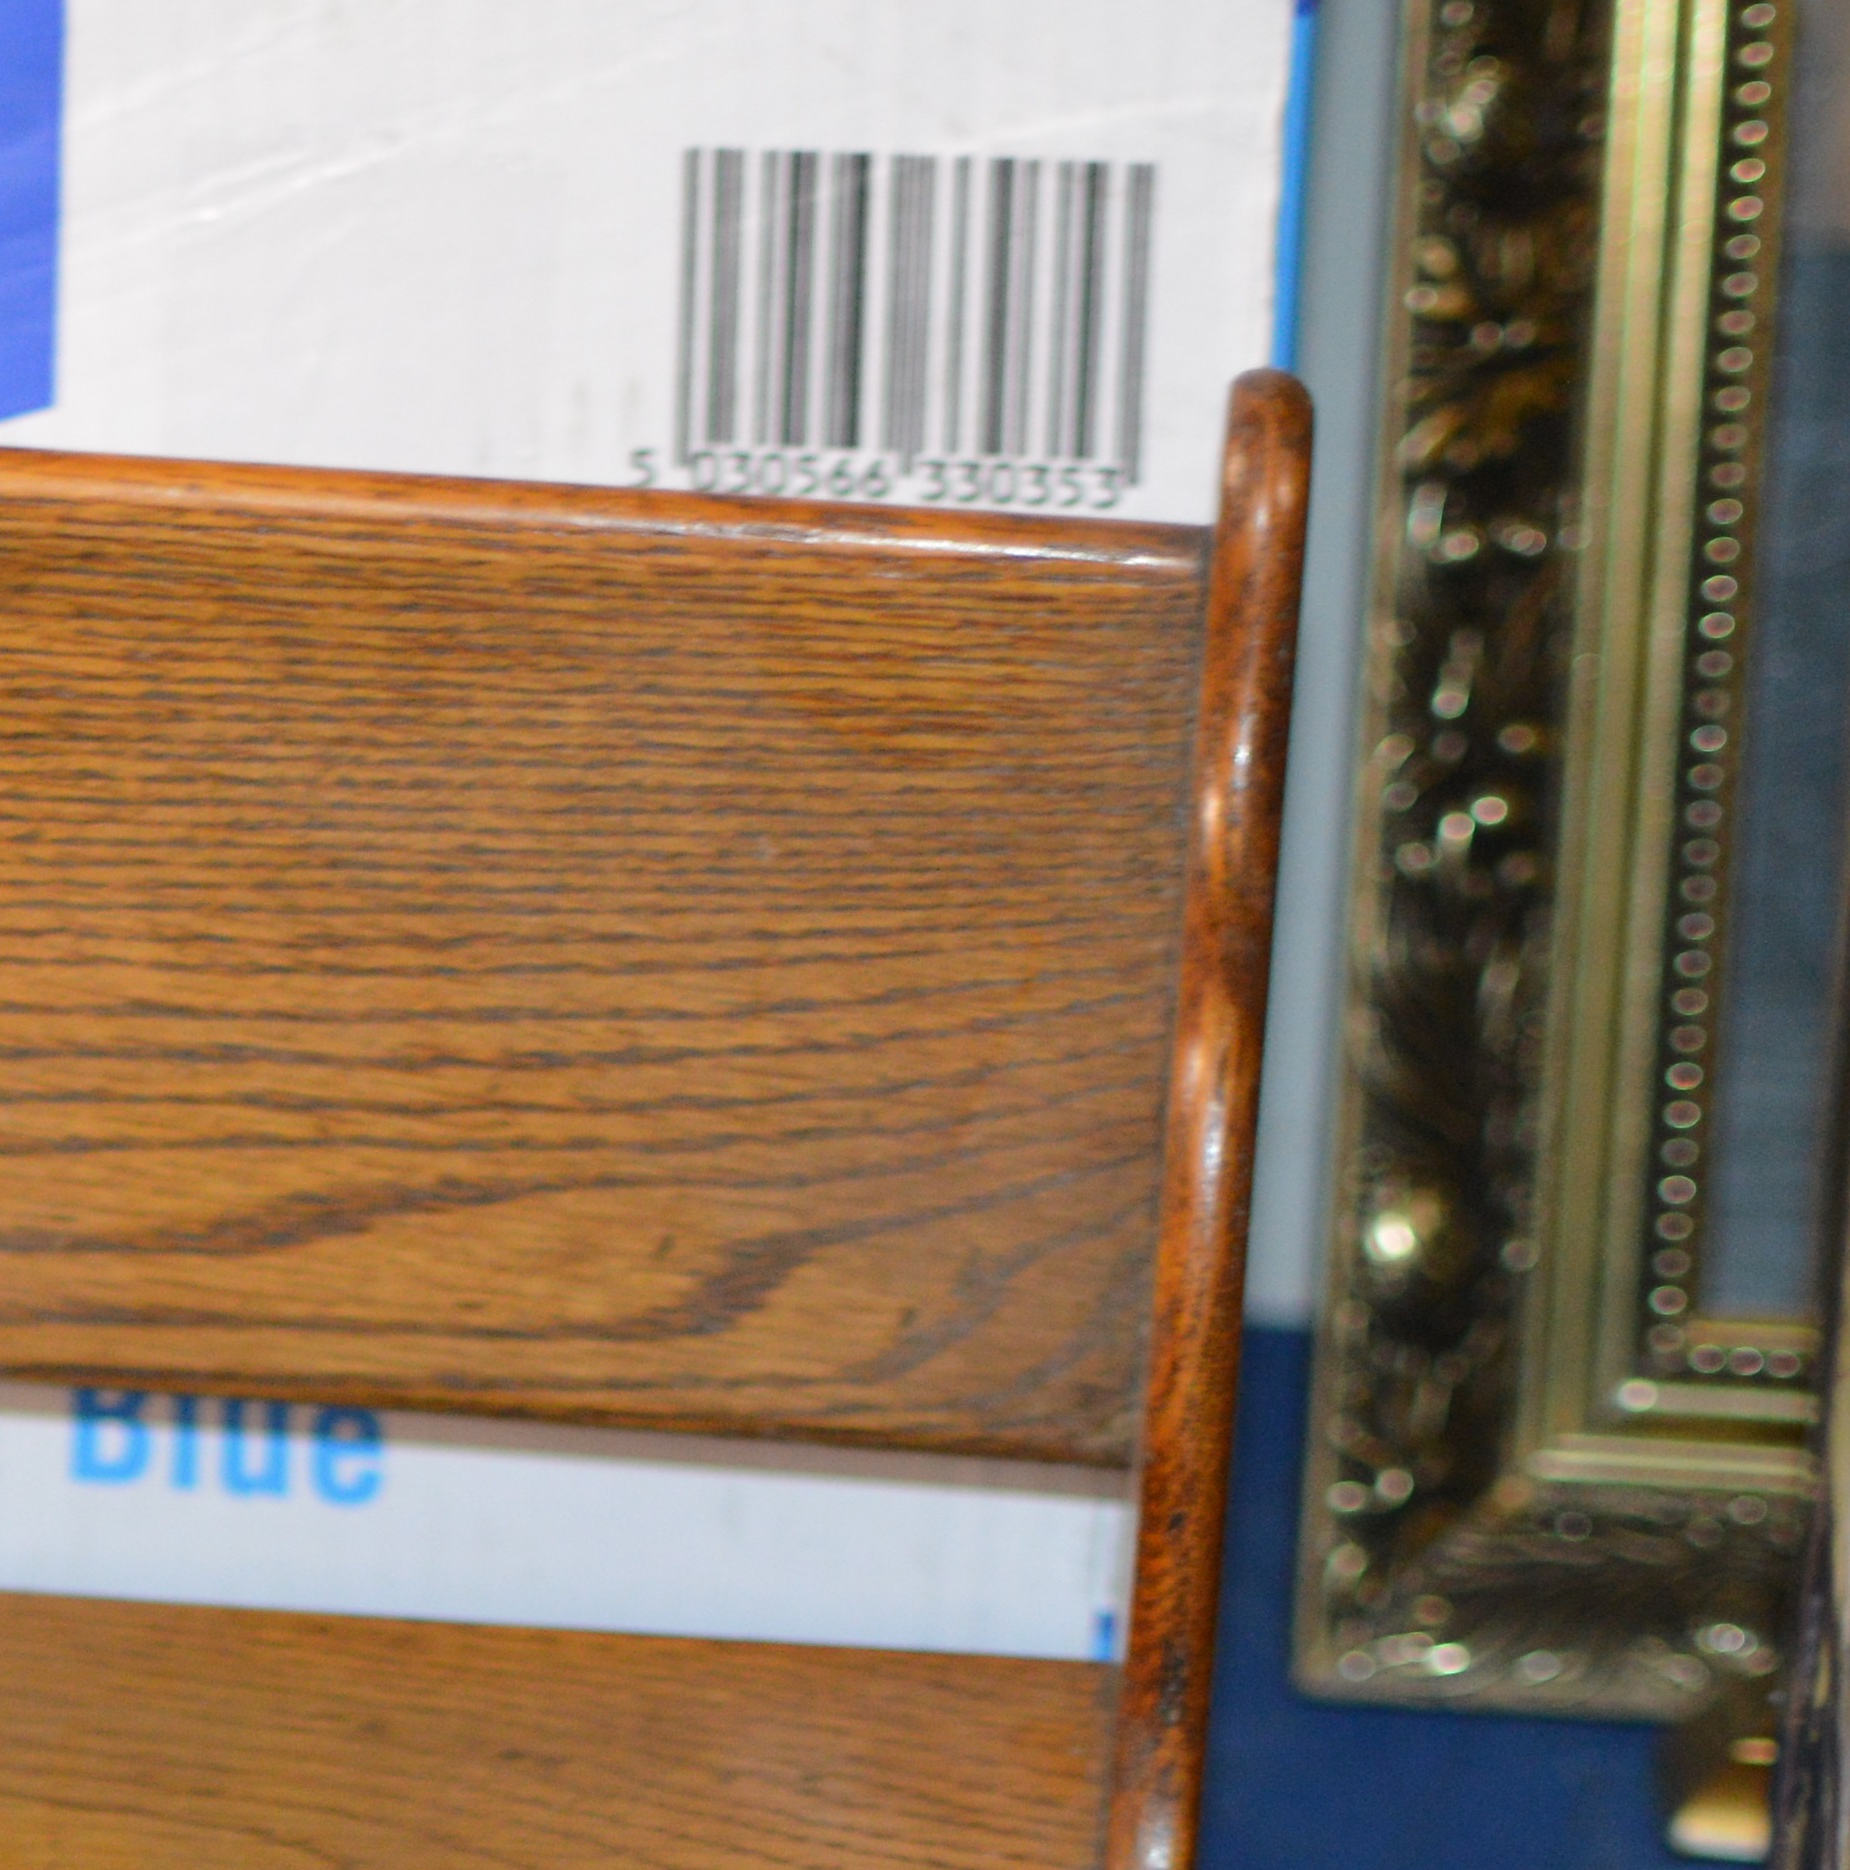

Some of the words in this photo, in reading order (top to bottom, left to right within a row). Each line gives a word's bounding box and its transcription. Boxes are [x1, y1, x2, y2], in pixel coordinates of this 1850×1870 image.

[629, 447, 656, 489] 5
[691, 449, 892, 499] 030566
[919, 457, 1124, 509] 330353
[70, 1386, 383, 1506] Blue
